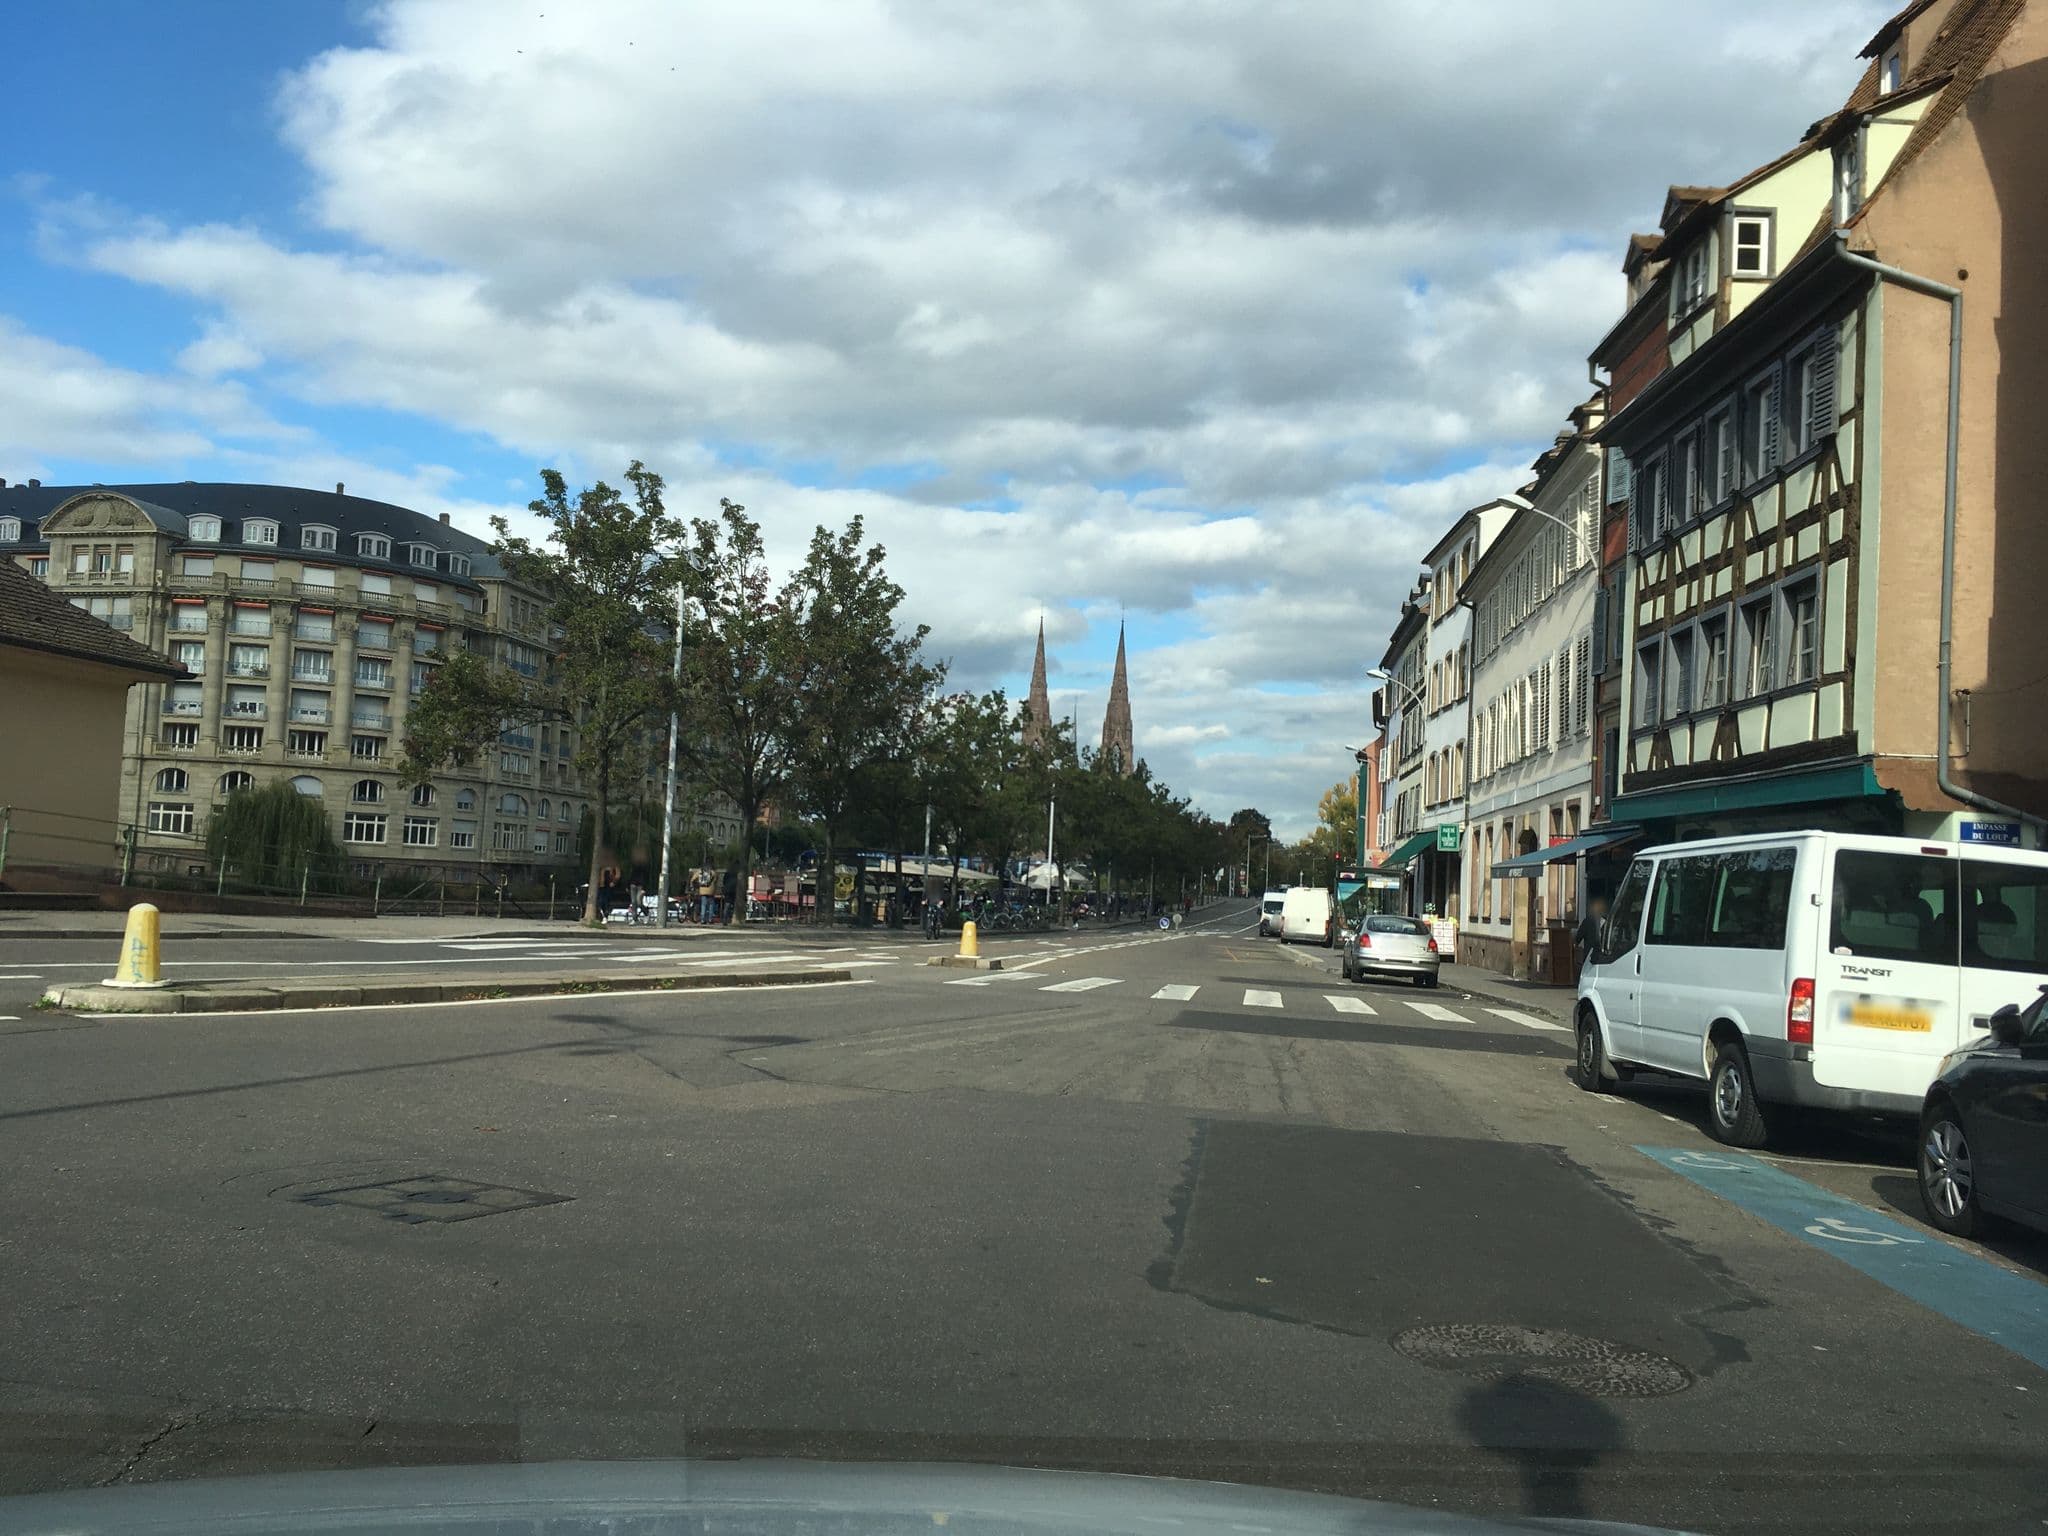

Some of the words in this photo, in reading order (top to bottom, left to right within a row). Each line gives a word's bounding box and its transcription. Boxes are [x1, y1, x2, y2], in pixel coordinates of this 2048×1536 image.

[1973, 823, 2008, 831] IMPASSE
[1972, 832, 1984, 840] DU
[1986, 833, 2008, 841] LOUP
[1841, 965, 1893, 977] TRANSIT
